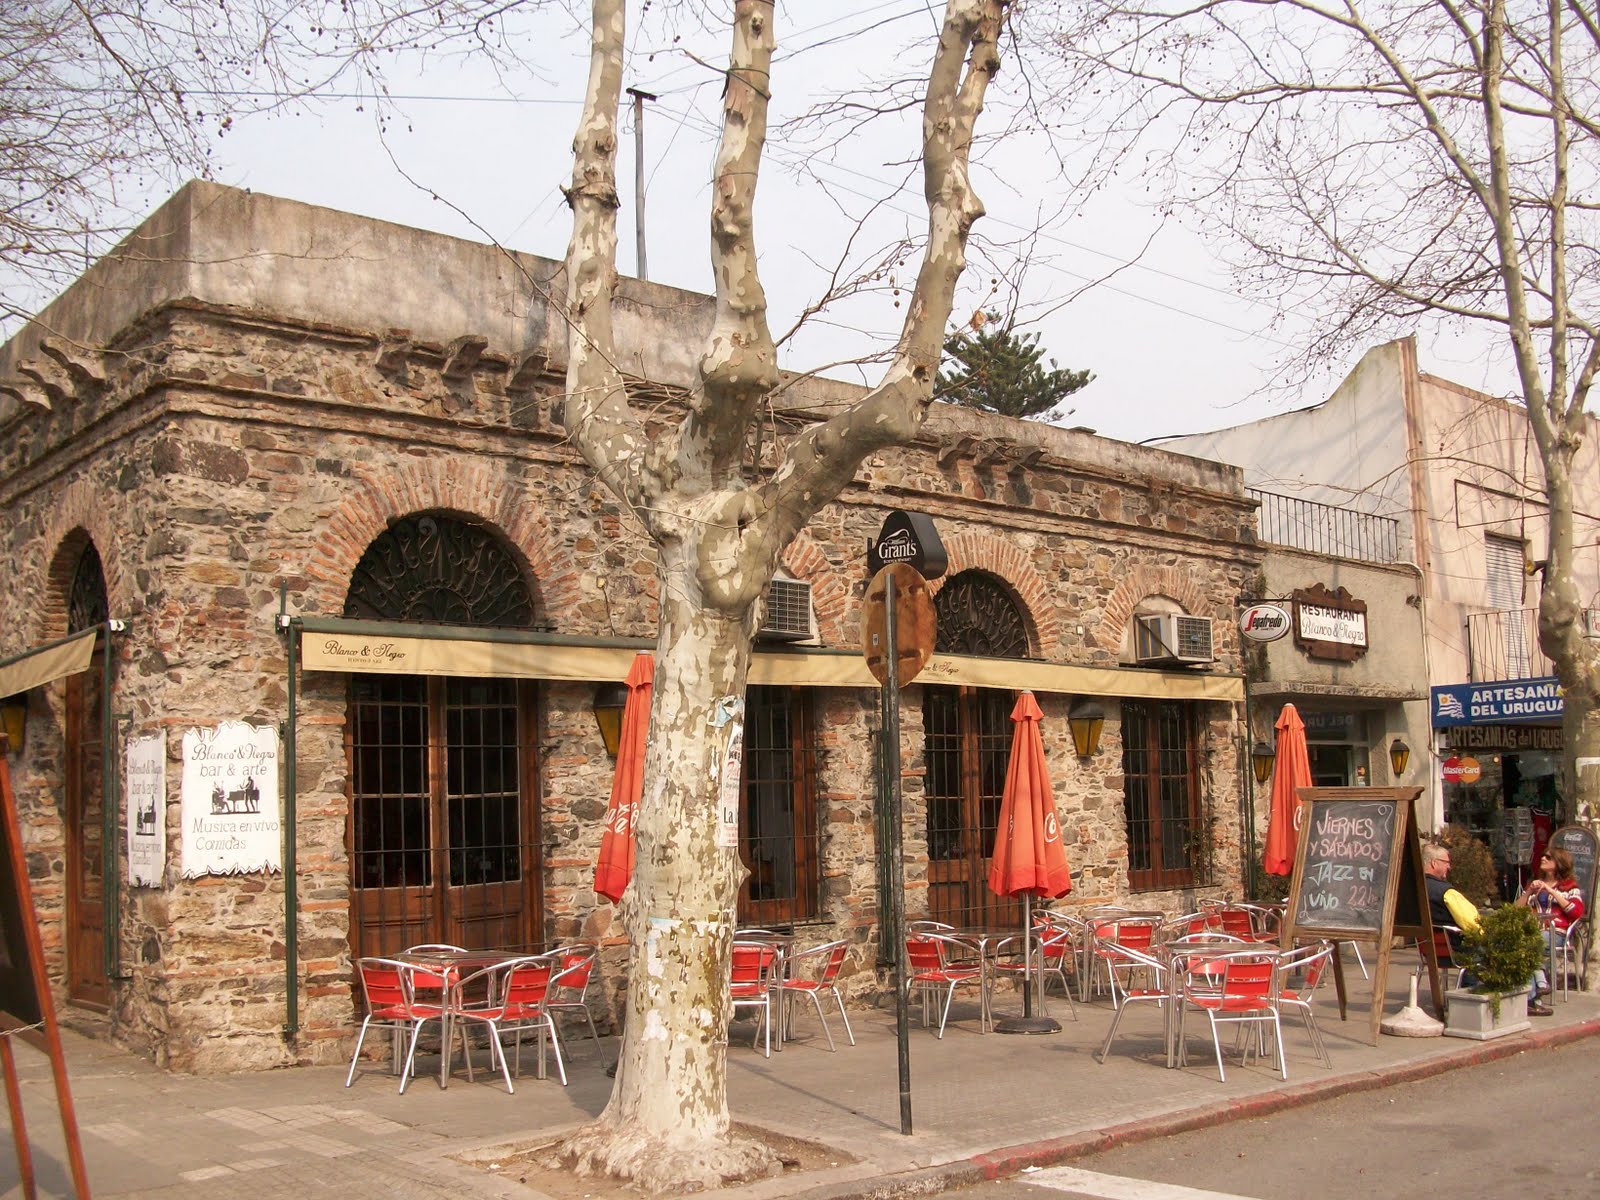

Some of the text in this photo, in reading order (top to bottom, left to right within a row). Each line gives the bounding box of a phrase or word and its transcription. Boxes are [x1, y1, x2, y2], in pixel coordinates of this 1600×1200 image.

[1244, 610, 1283, 632] Segafredo
[1301, 604, 1360, 622] RESTAURANT
[1302, 617, 1364, 644] Blanco & Negro
[322, 640, 406, 662] Blanco & Negro
[1471, 684, 1564, 704] ARTESANIA
[1470, 699, 1564, 717] DEL URUGUA
[1447, 726, 1516, 748] ARTESANIAS
[192, 743, 275, 766] Blanco & Negro
[200, 763, 268, 778] bar & arte
[1443, 766, 1480, 775] MasterCard
[723, 806, 734, 824] La
[192, 817, 279, 834] Musica en vivo
[195, 836, 247, 851] Comidas
[1308, 861, 1354, 887] JAZZ
